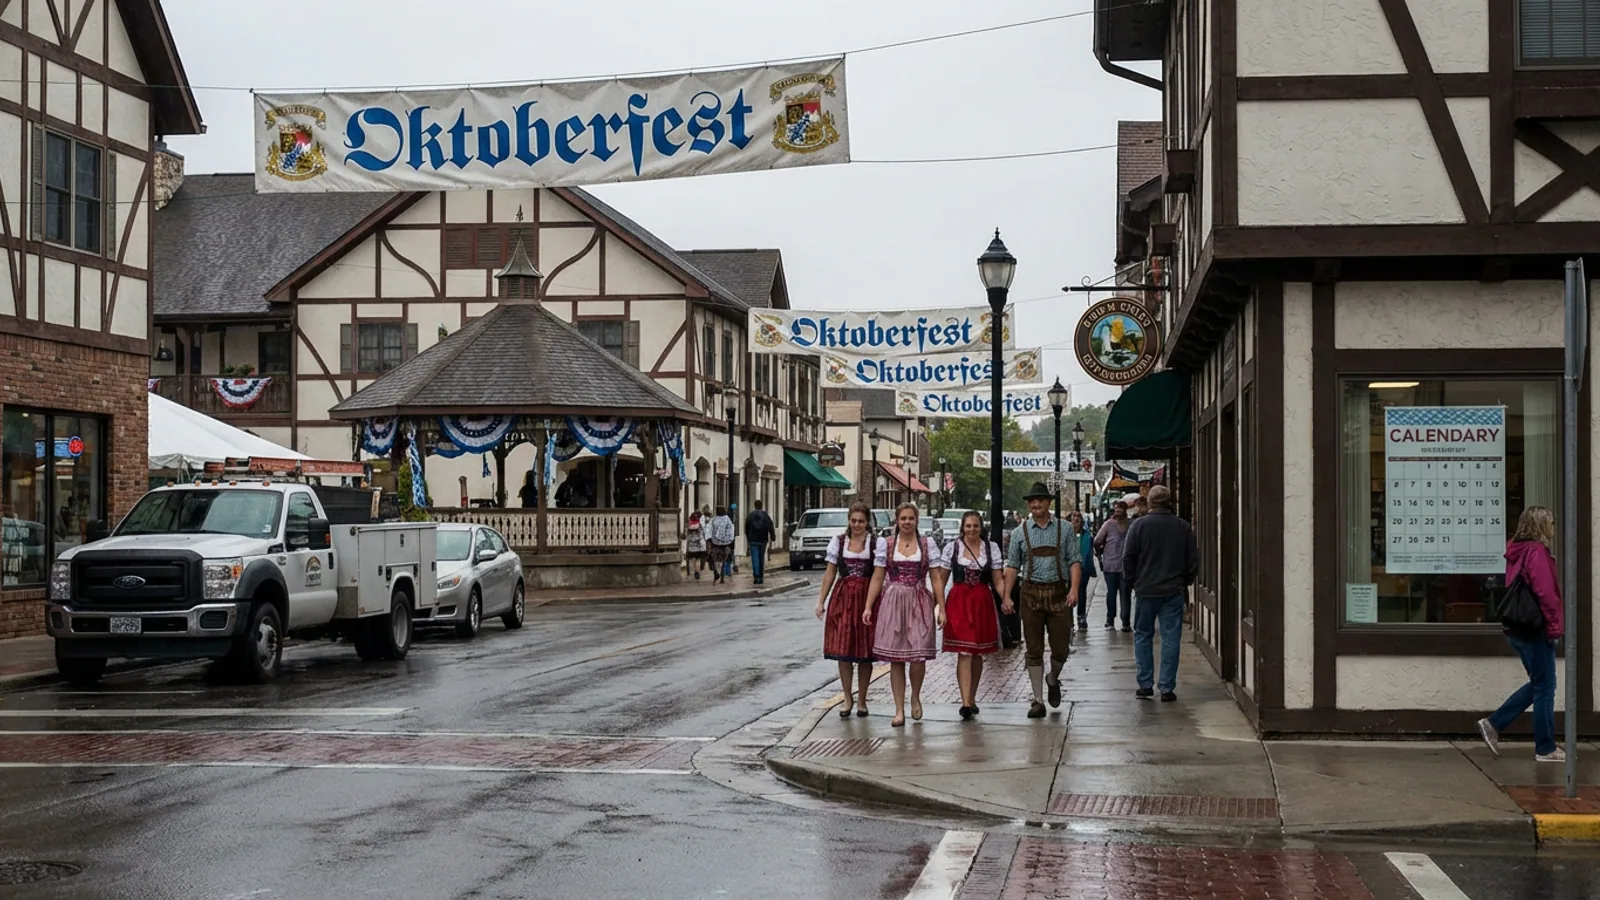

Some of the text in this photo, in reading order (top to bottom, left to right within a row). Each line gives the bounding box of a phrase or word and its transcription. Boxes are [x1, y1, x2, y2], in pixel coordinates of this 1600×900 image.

[343, 89, 754, 177] Oktoberfest
[790, 317, 973, 353] Oktoberfest
[856, 356, 1006, 386] Oktoberfes
[923, 393, 1041, 414] Oktobefest
[1389, 428, 1500, 443] CALENDARY
[1459, 499, 1467, 507] 17
